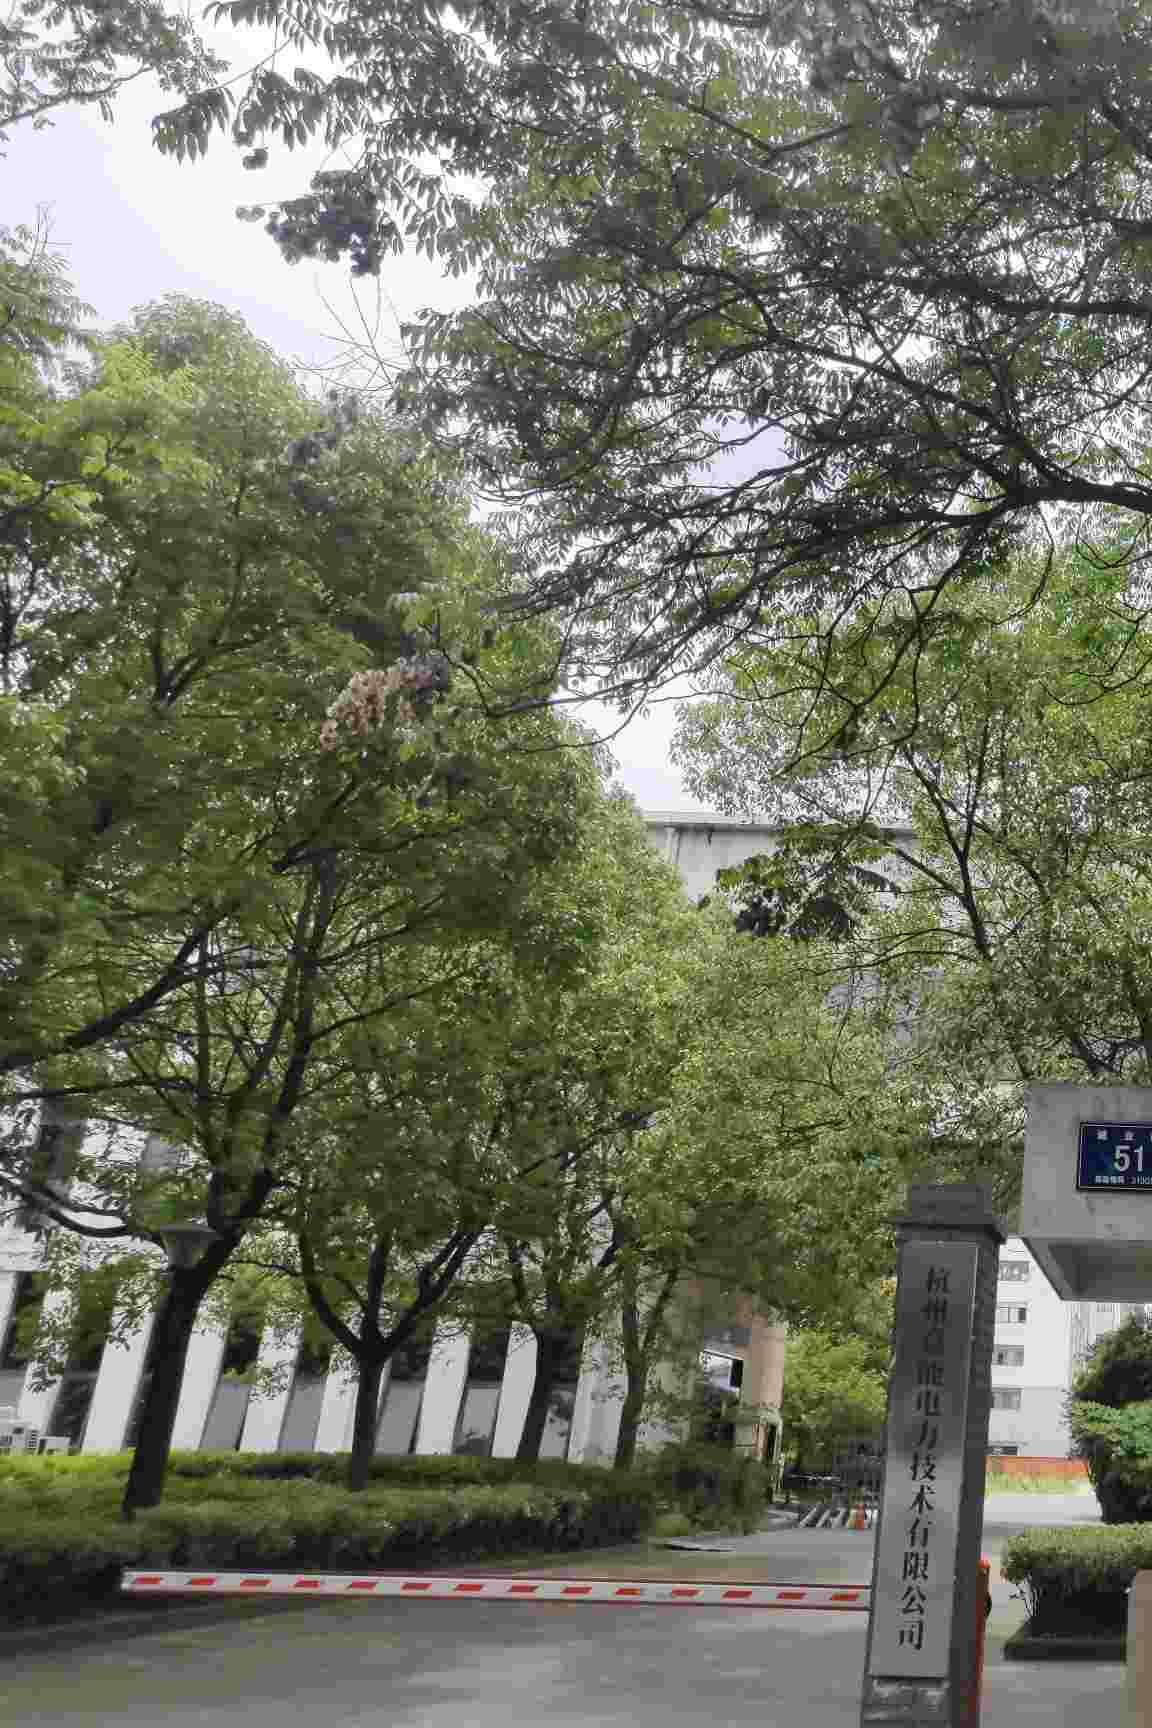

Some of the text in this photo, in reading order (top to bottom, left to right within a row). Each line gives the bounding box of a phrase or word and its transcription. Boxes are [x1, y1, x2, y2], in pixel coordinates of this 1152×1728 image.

[1113, 1145, 1144, 1171] 51
[897, 1265, 952, 1651] 杭州能电力技术有限公司
